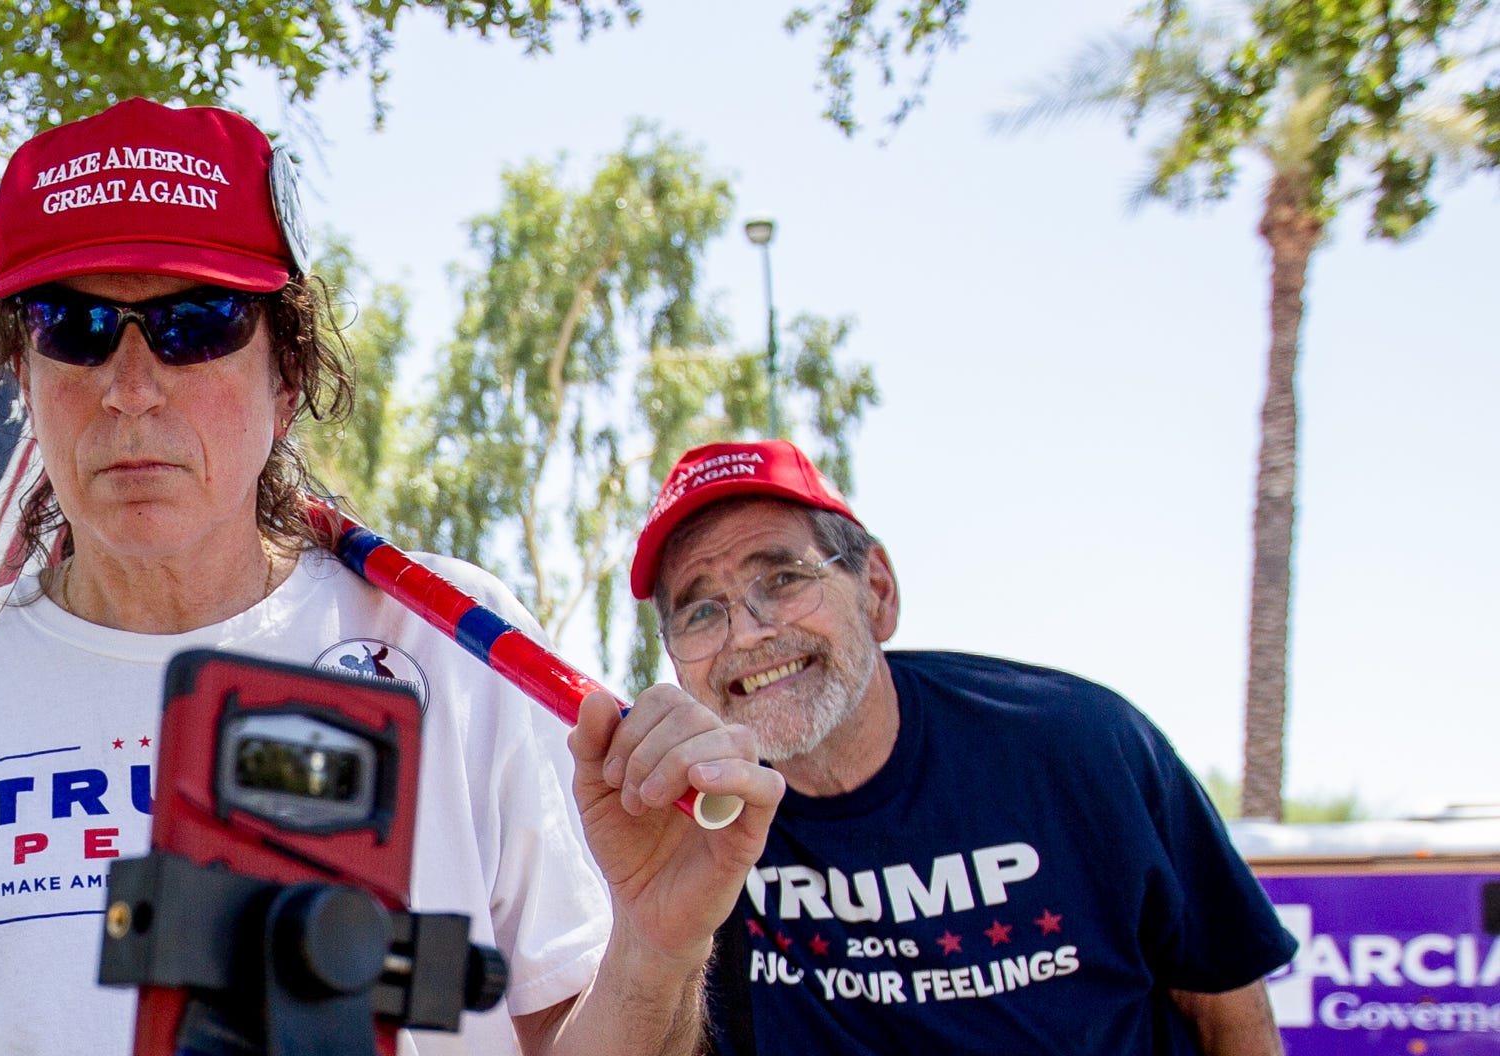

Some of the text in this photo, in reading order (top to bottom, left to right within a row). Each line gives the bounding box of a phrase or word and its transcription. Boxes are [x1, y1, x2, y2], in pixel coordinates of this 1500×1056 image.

[32, 147, 230, 190] MAKE AMERICA
[43, 179, 218, 215] GREAT AGAIN
[675, 452, 764, 486] AMERICA
[692, 463, 756, 488] AGAIN
[1, 874, 111, 896] MAKE AM
[746, 842, 1040, 923] TRUMP
[846, 937, 920, 958] 2016
[1266, 933, 1500, 988] ARCI
[750, 945, 1080, 1004] FUC YOUR FEELINGS
